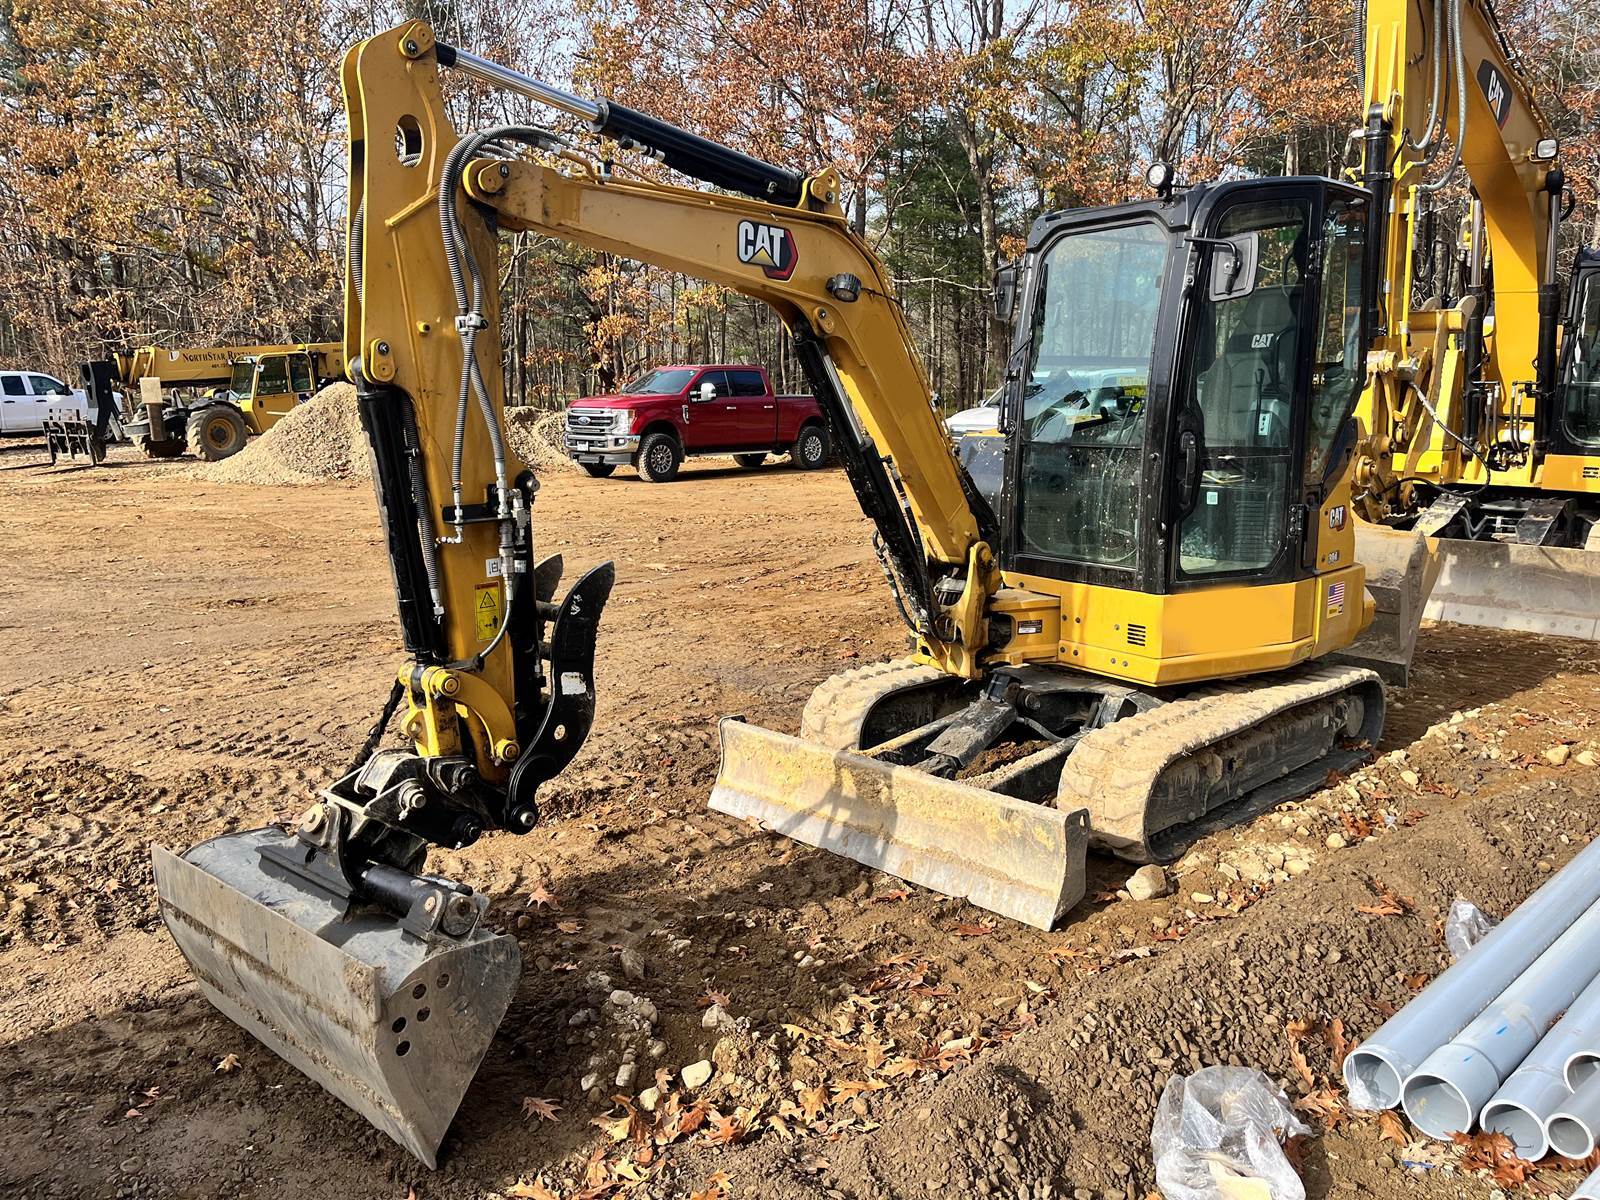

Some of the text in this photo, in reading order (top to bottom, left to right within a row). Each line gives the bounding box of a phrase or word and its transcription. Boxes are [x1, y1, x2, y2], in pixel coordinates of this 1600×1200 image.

[1487, 69, 1504, 121] CAT
[738, 220, 785, 267] CAT
[1250, 333, 1275, 349] CAT
[1329, 505, 1345, 529] CAT
